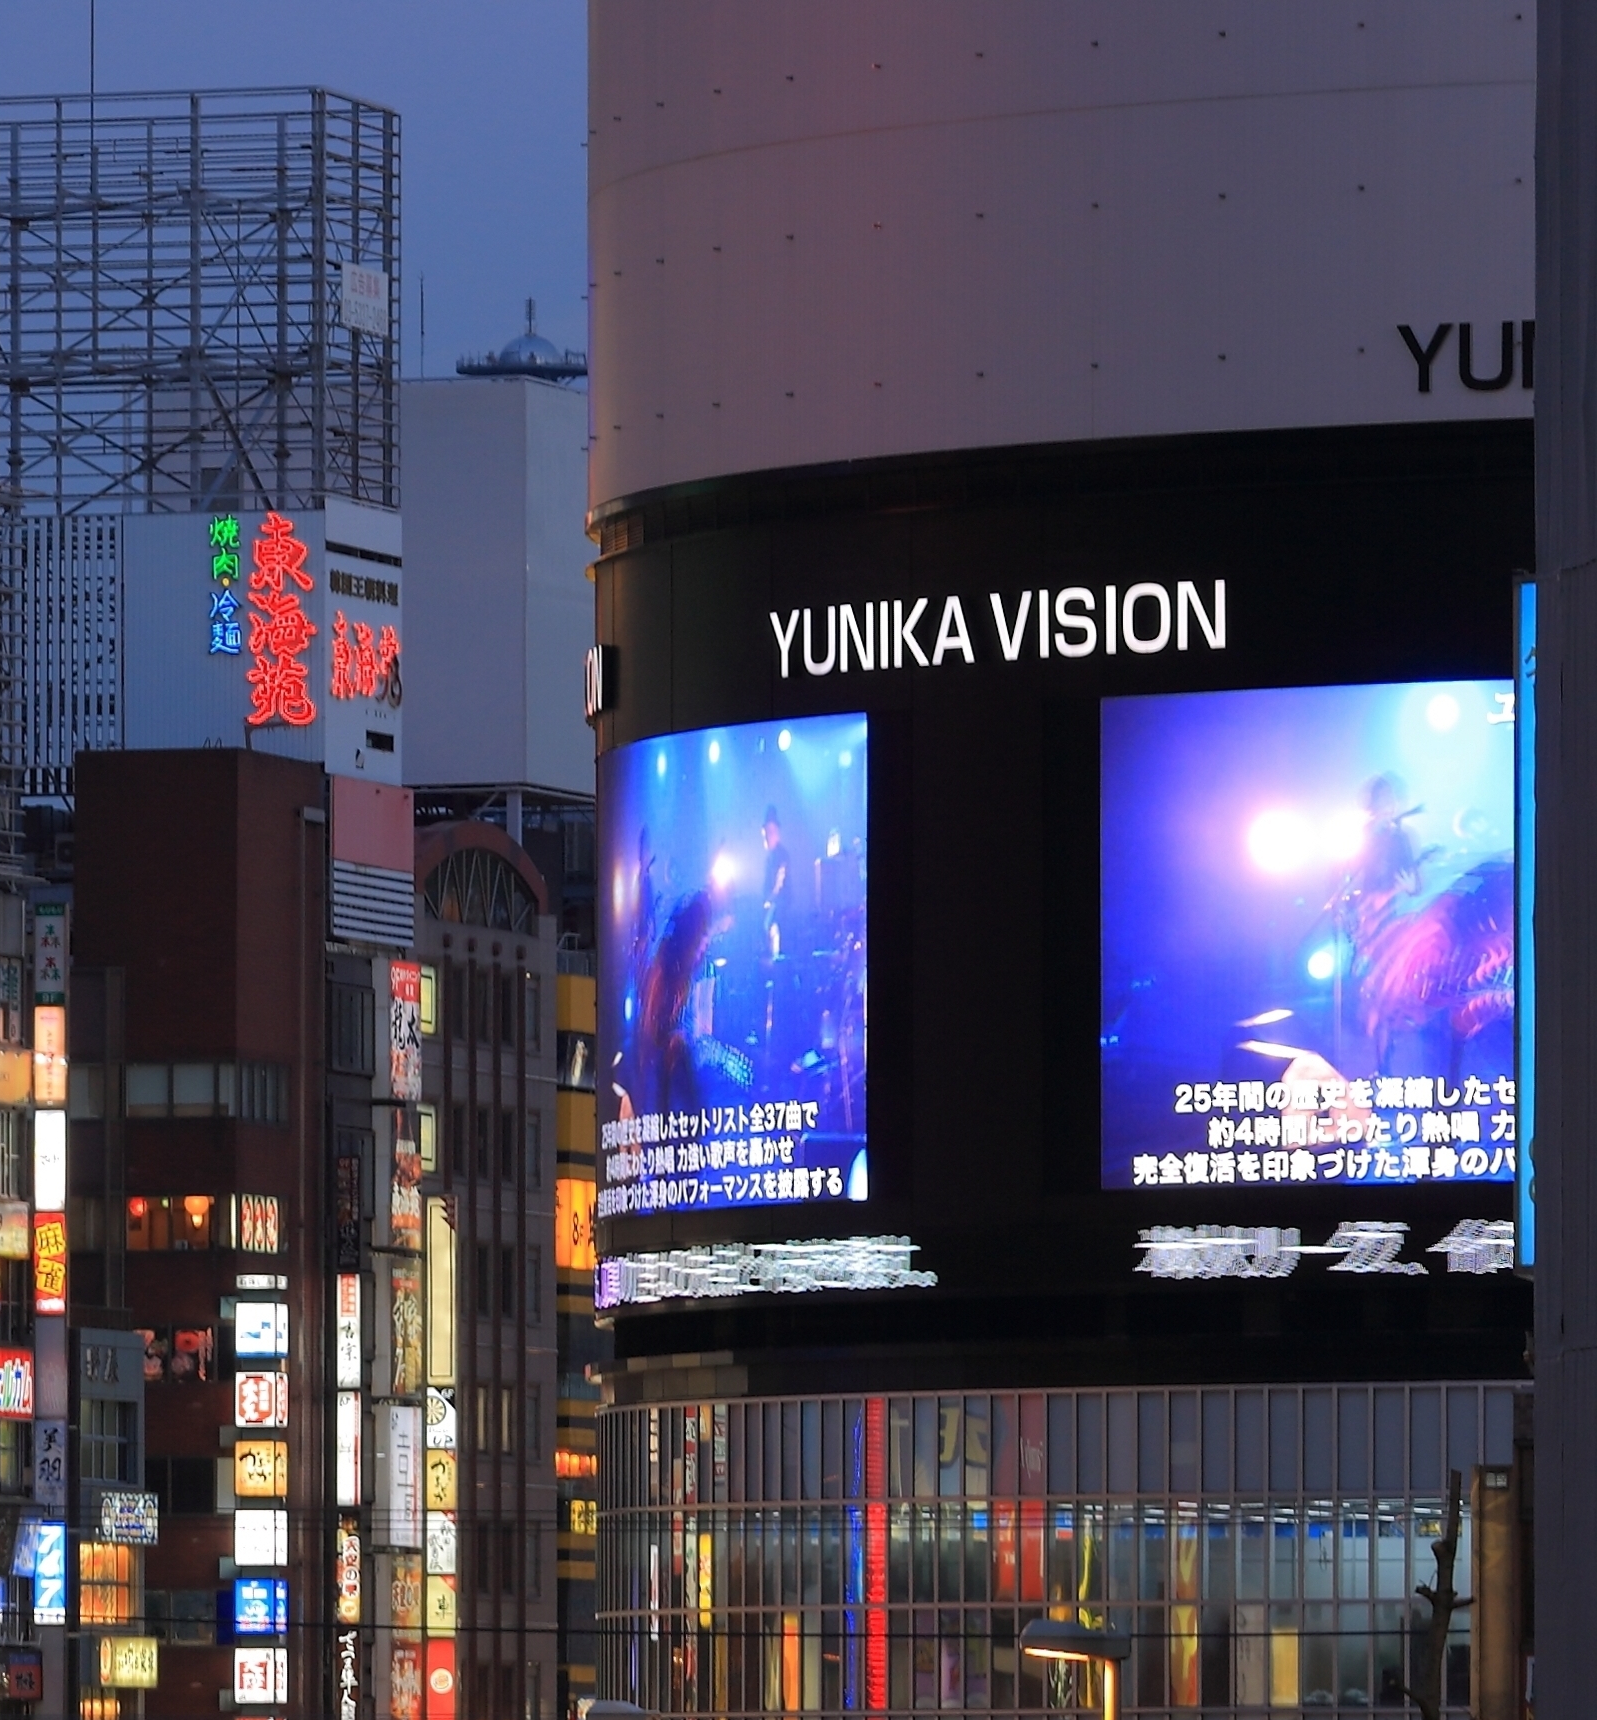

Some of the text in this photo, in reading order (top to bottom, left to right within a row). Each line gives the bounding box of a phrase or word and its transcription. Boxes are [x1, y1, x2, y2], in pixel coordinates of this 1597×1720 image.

[770, 579, 1227, 678] YUNIKA VISION
[35, 1222, 65, 1294] 麻雀
